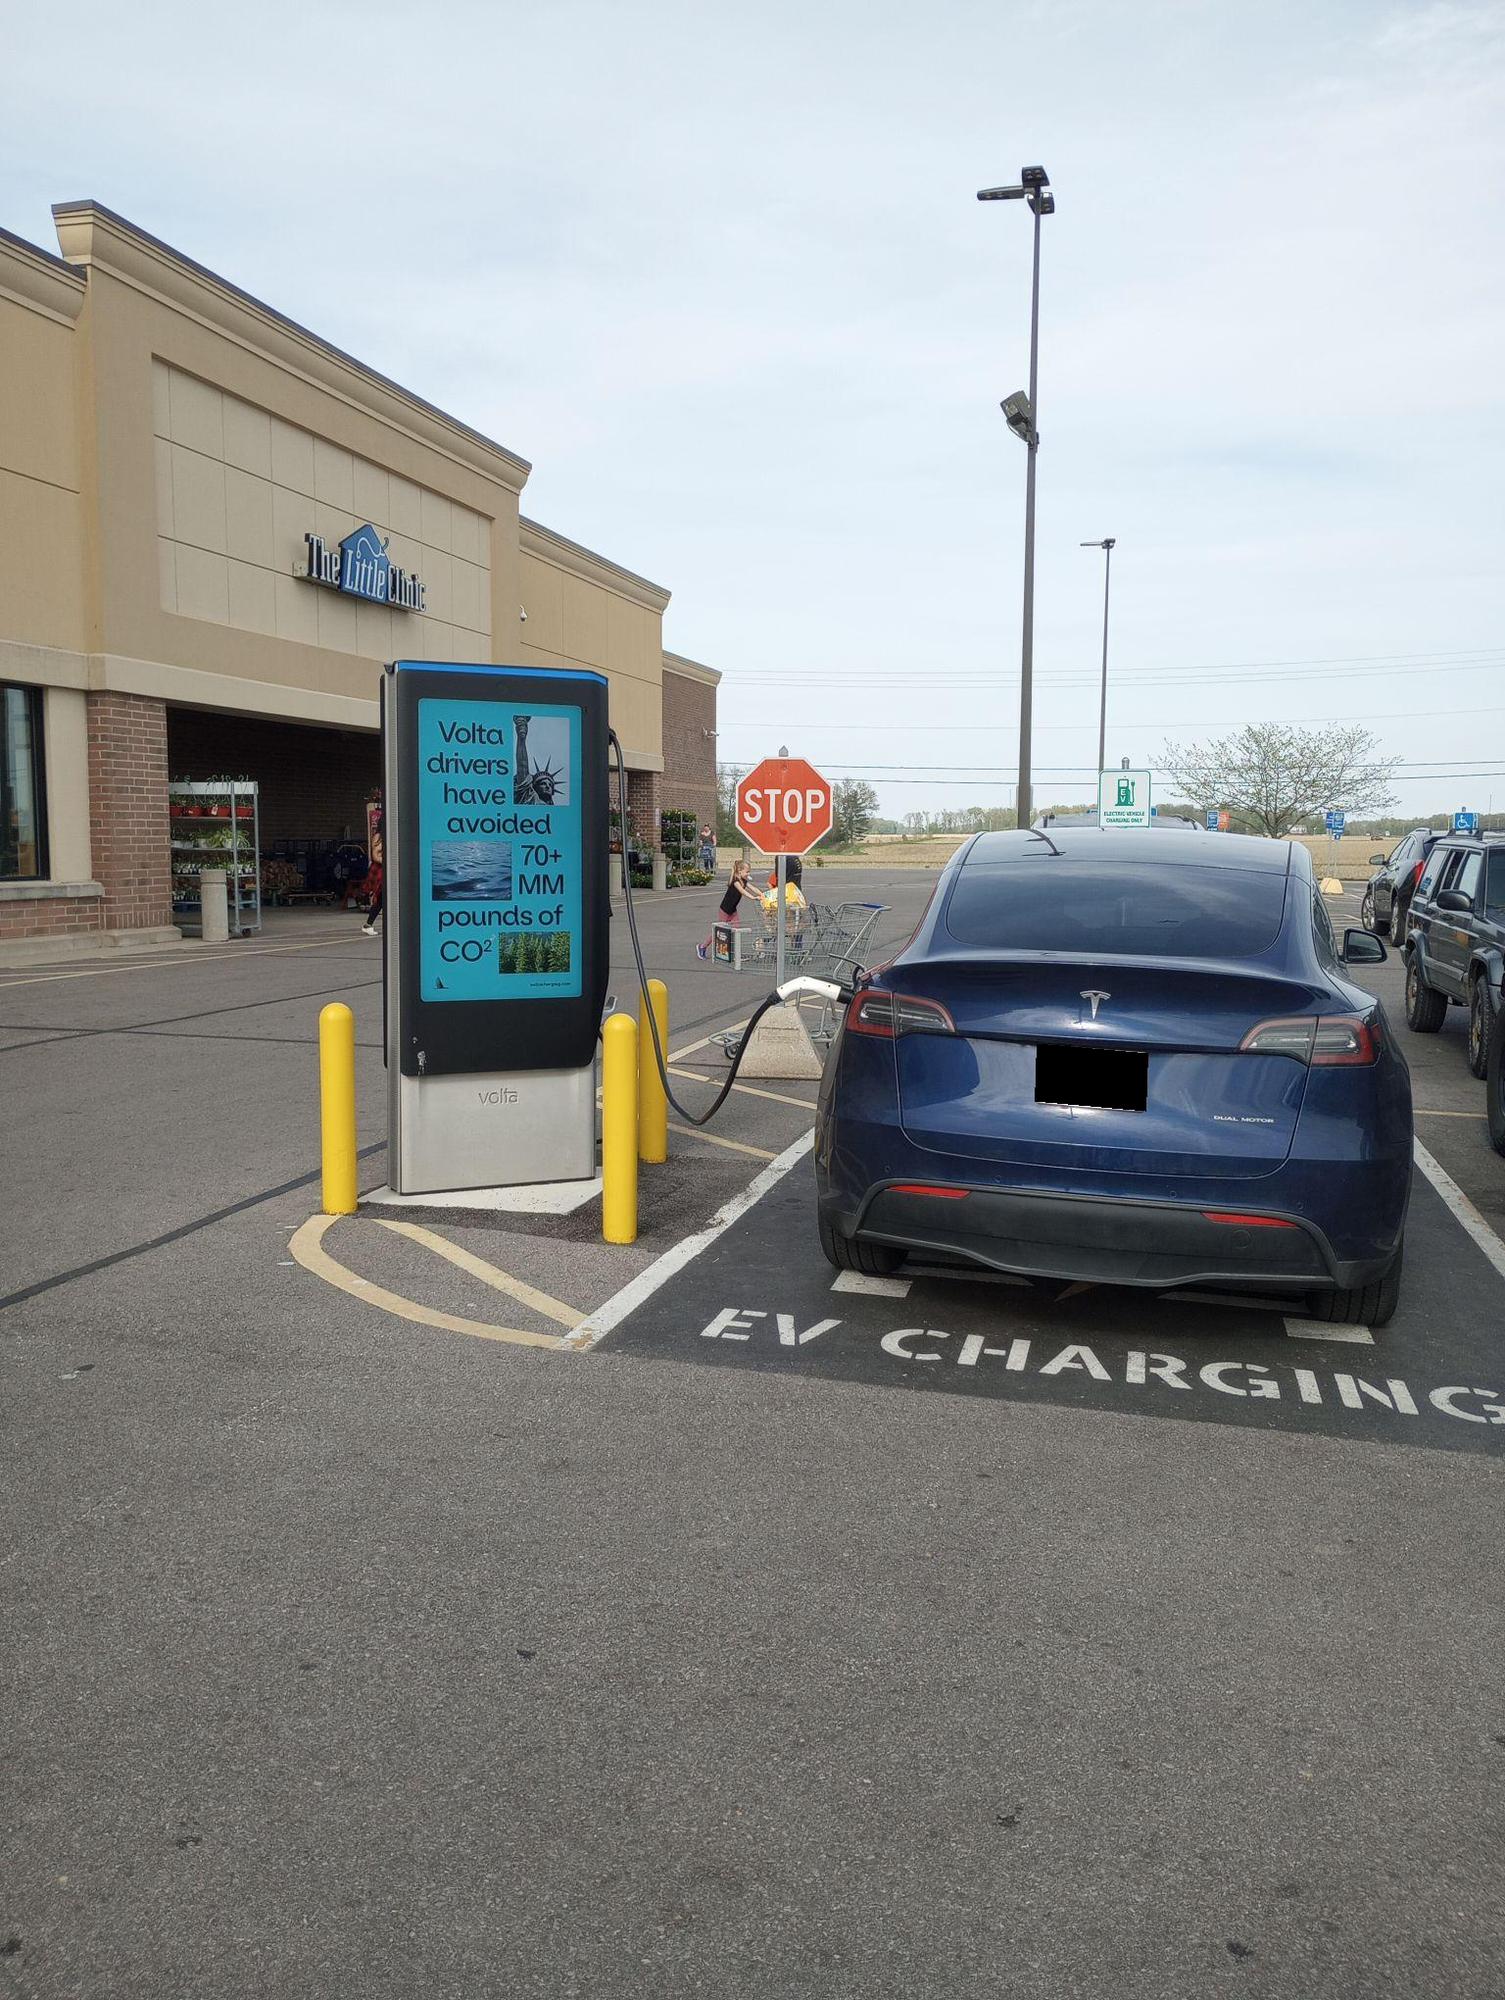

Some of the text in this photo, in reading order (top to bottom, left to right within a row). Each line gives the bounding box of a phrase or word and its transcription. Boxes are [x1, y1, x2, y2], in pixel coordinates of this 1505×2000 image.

[304, 533, 427, 612] The Little Clinic
[438, 720, 504, 745] Volta
[427, 752, 509, 775] drivers
[443, 783, 506, 805] have
[743, 788, 825, 824] STOP
[447, 813, 551, 835] avoided
[520, 844, 562, 866] 70+
[518, 873, 564, 895] MM
[438, 904, 564, 933] pounds of
[700, 1308, 1505, 1425] EV CHARGING
